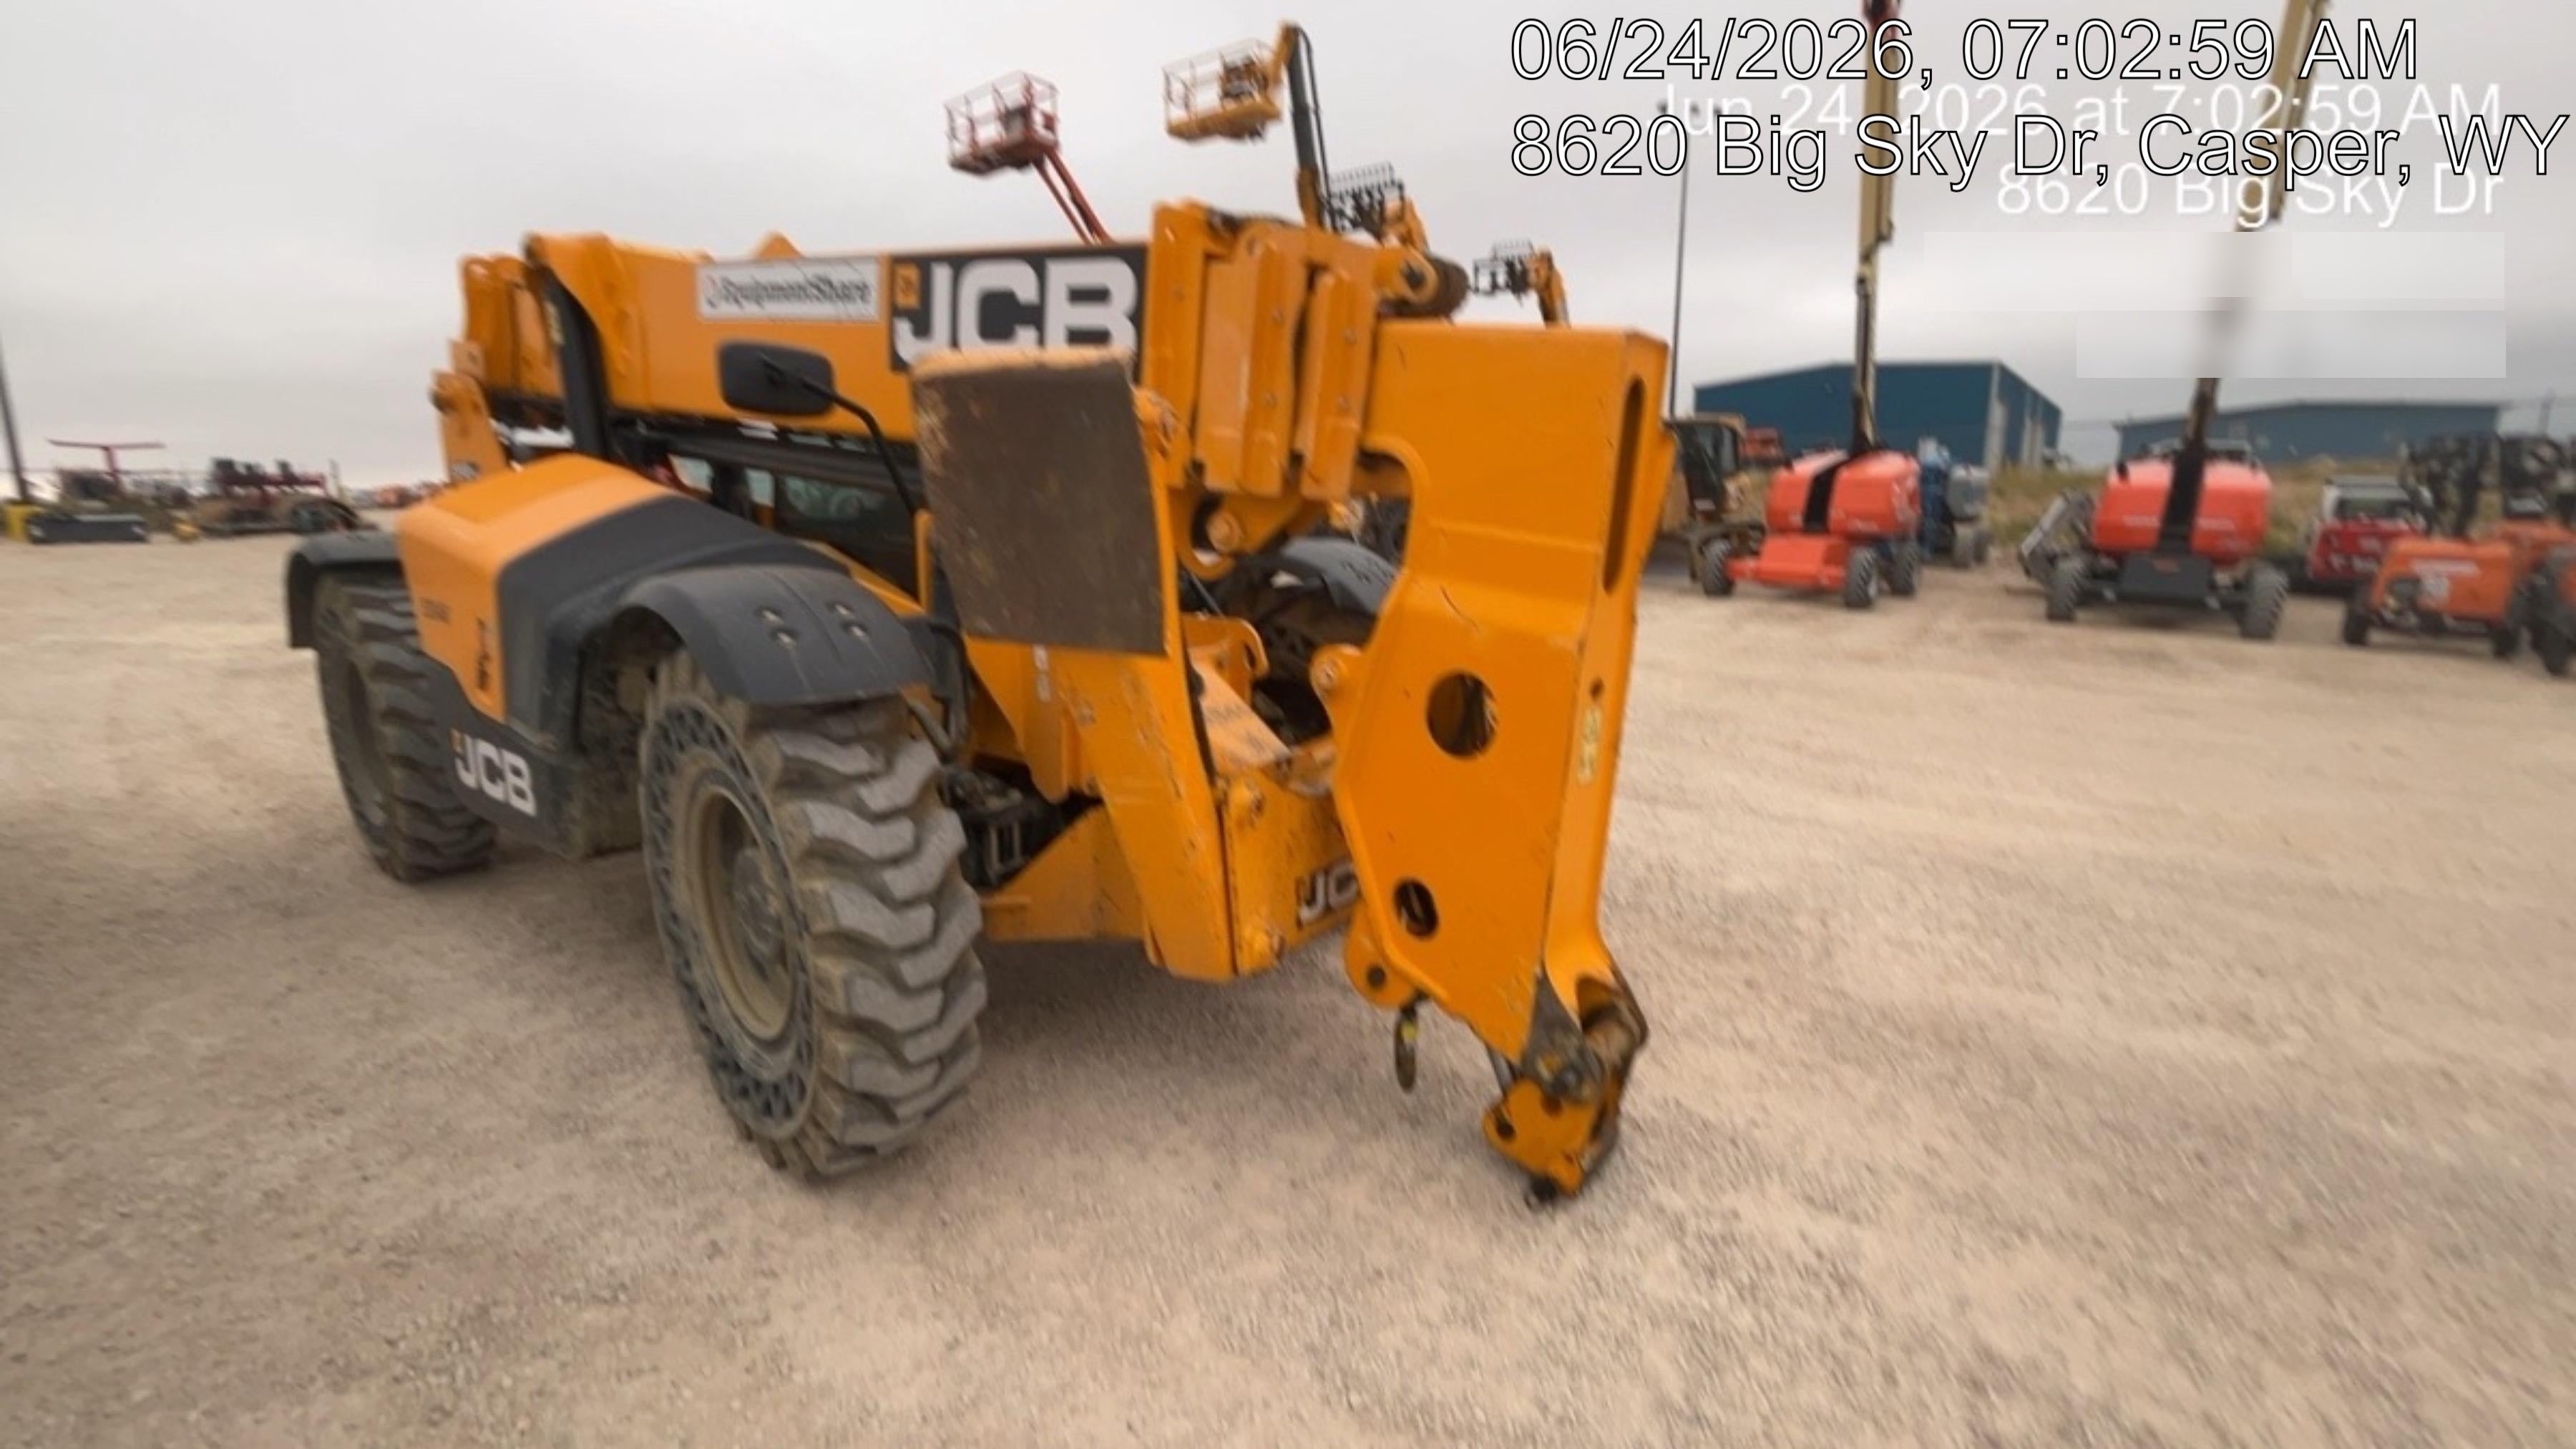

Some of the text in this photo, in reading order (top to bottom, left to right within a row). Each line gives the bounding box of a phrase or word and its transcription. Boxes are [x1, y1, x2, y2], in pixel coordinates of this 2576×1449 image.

[894, 258, 1136, 366] JCB
[455, 733, 537, 816] JCB
[1298, 862, 1358, 924] JC
